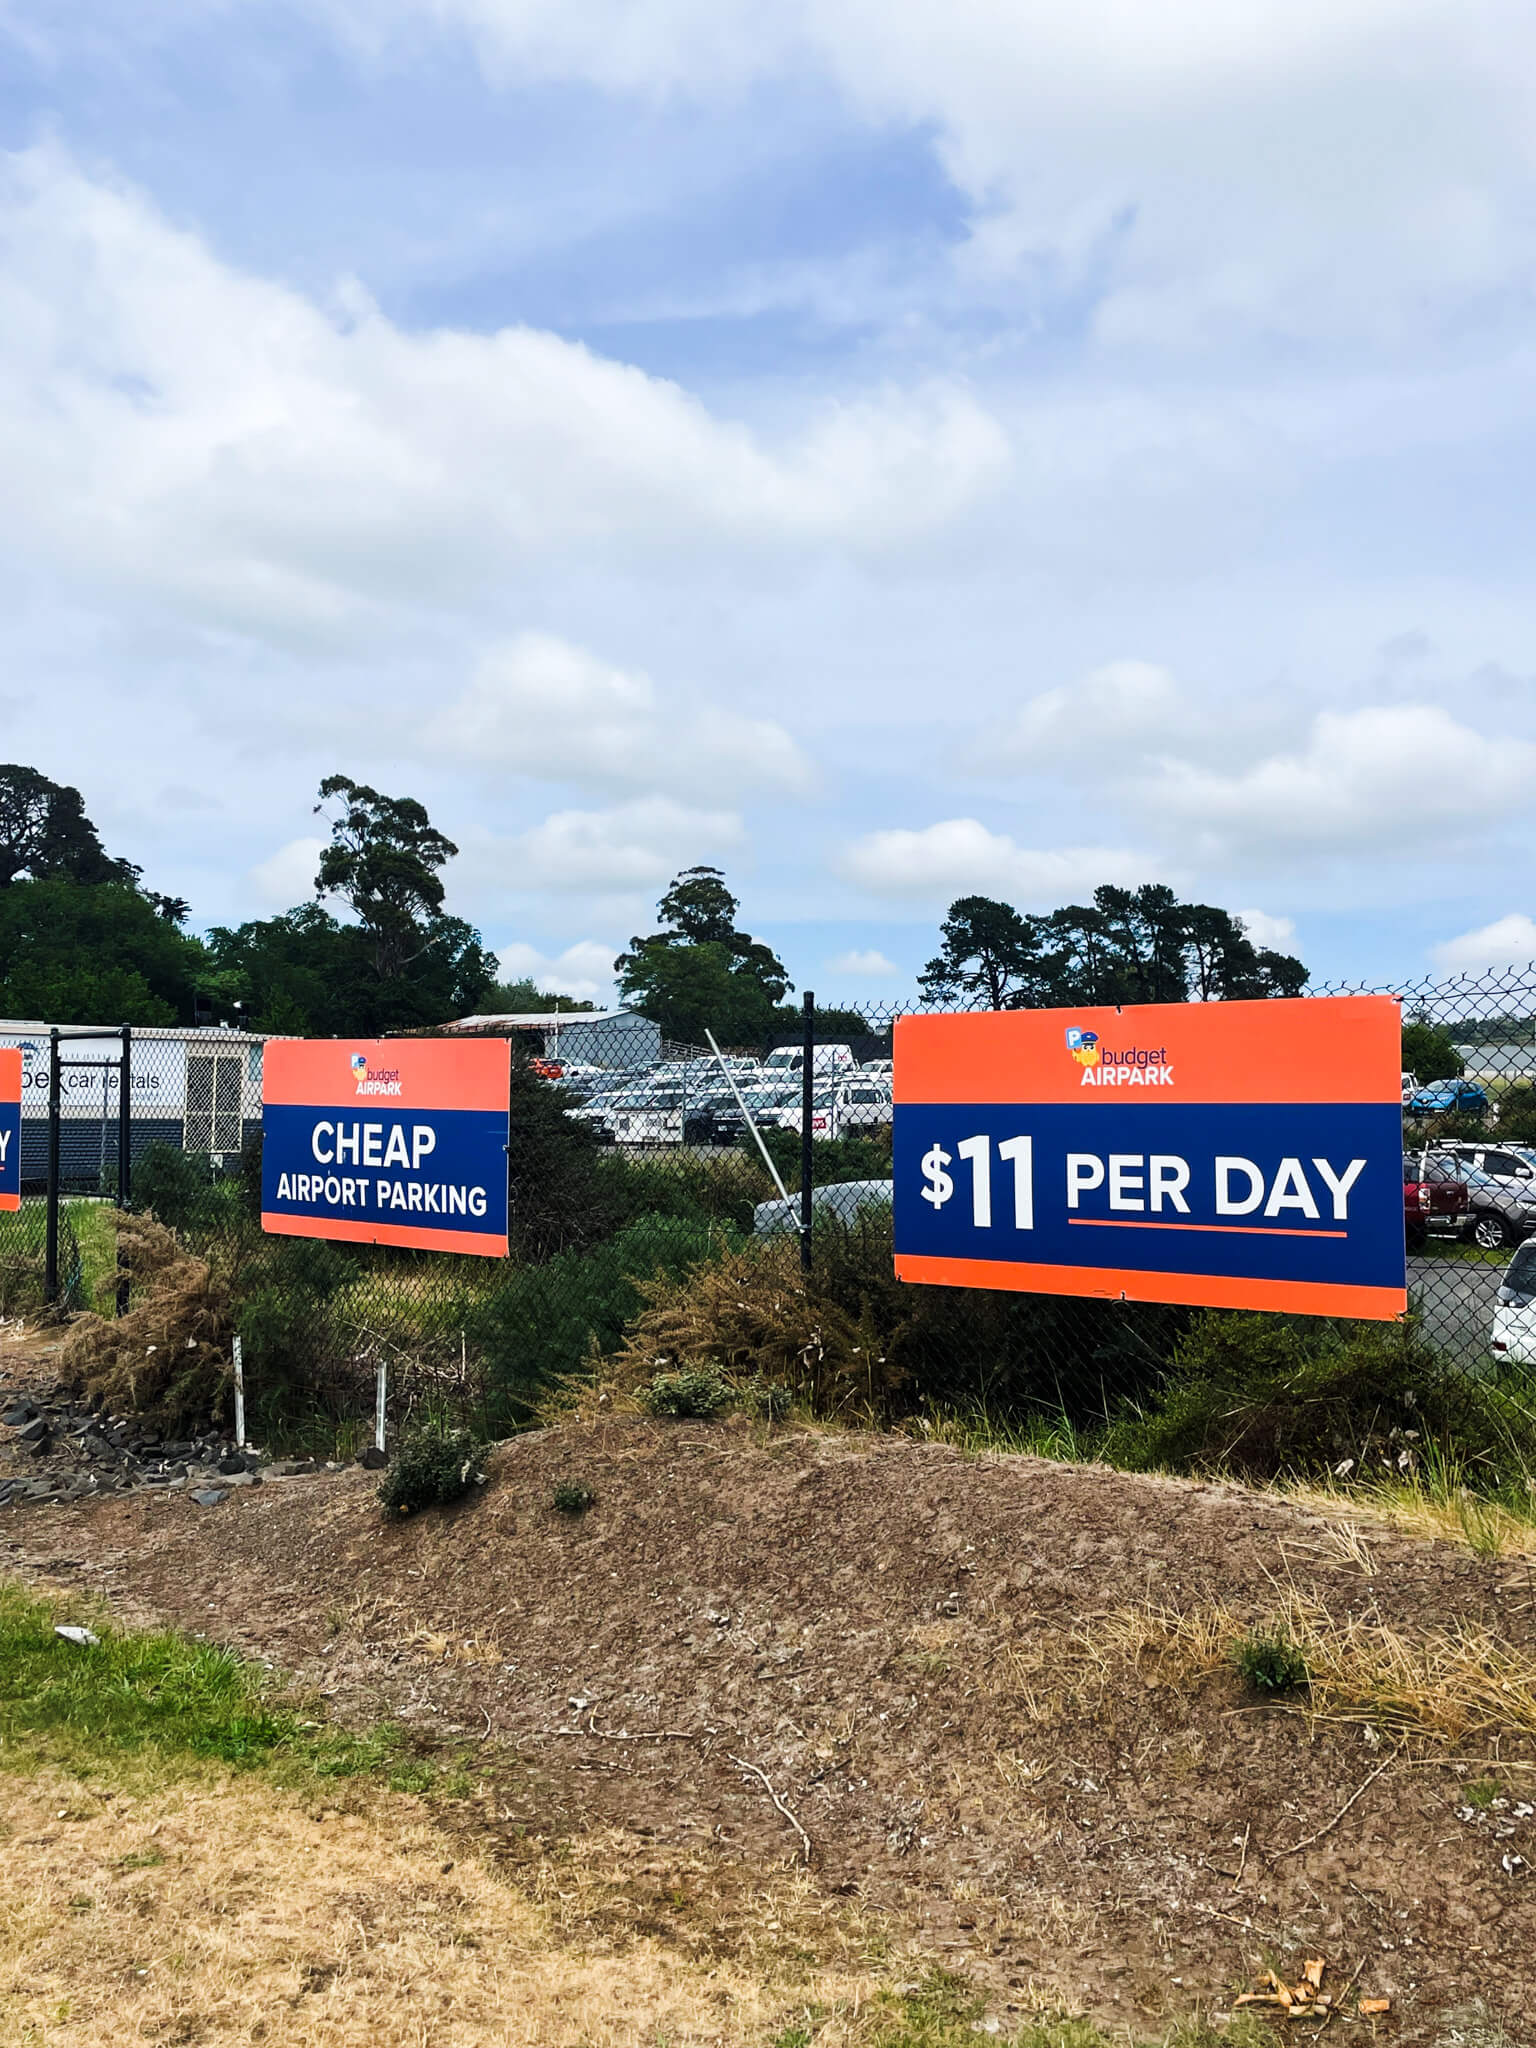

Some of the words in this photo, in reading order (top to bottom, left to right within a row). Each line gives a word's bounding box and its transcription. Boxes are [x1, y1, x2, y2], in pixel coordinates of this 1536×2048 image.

[1068, 1030, 1081, 1046] P
[1102, 1047, 1167, 1070] budget
[68, 1074, 97, 1088] car
[102, 1072, 160, 1089] retals
[366, 1067, 399, 1084] budget
[1080, 1066, 1175, 1086] AIRPARK
[355, 1081, 403, 1096] AIRPARK
[312, 1121, 436, 1169] CHEAP
[920, 1134, 1034, 1231] $11
[1066, 1153, 1191, 1214] PER
[1214, 1156, 1368, 1221] DAY
[276, 1173, 370, 1207] AIRPORT
[376, 1179, 488, 1217] PARKING
